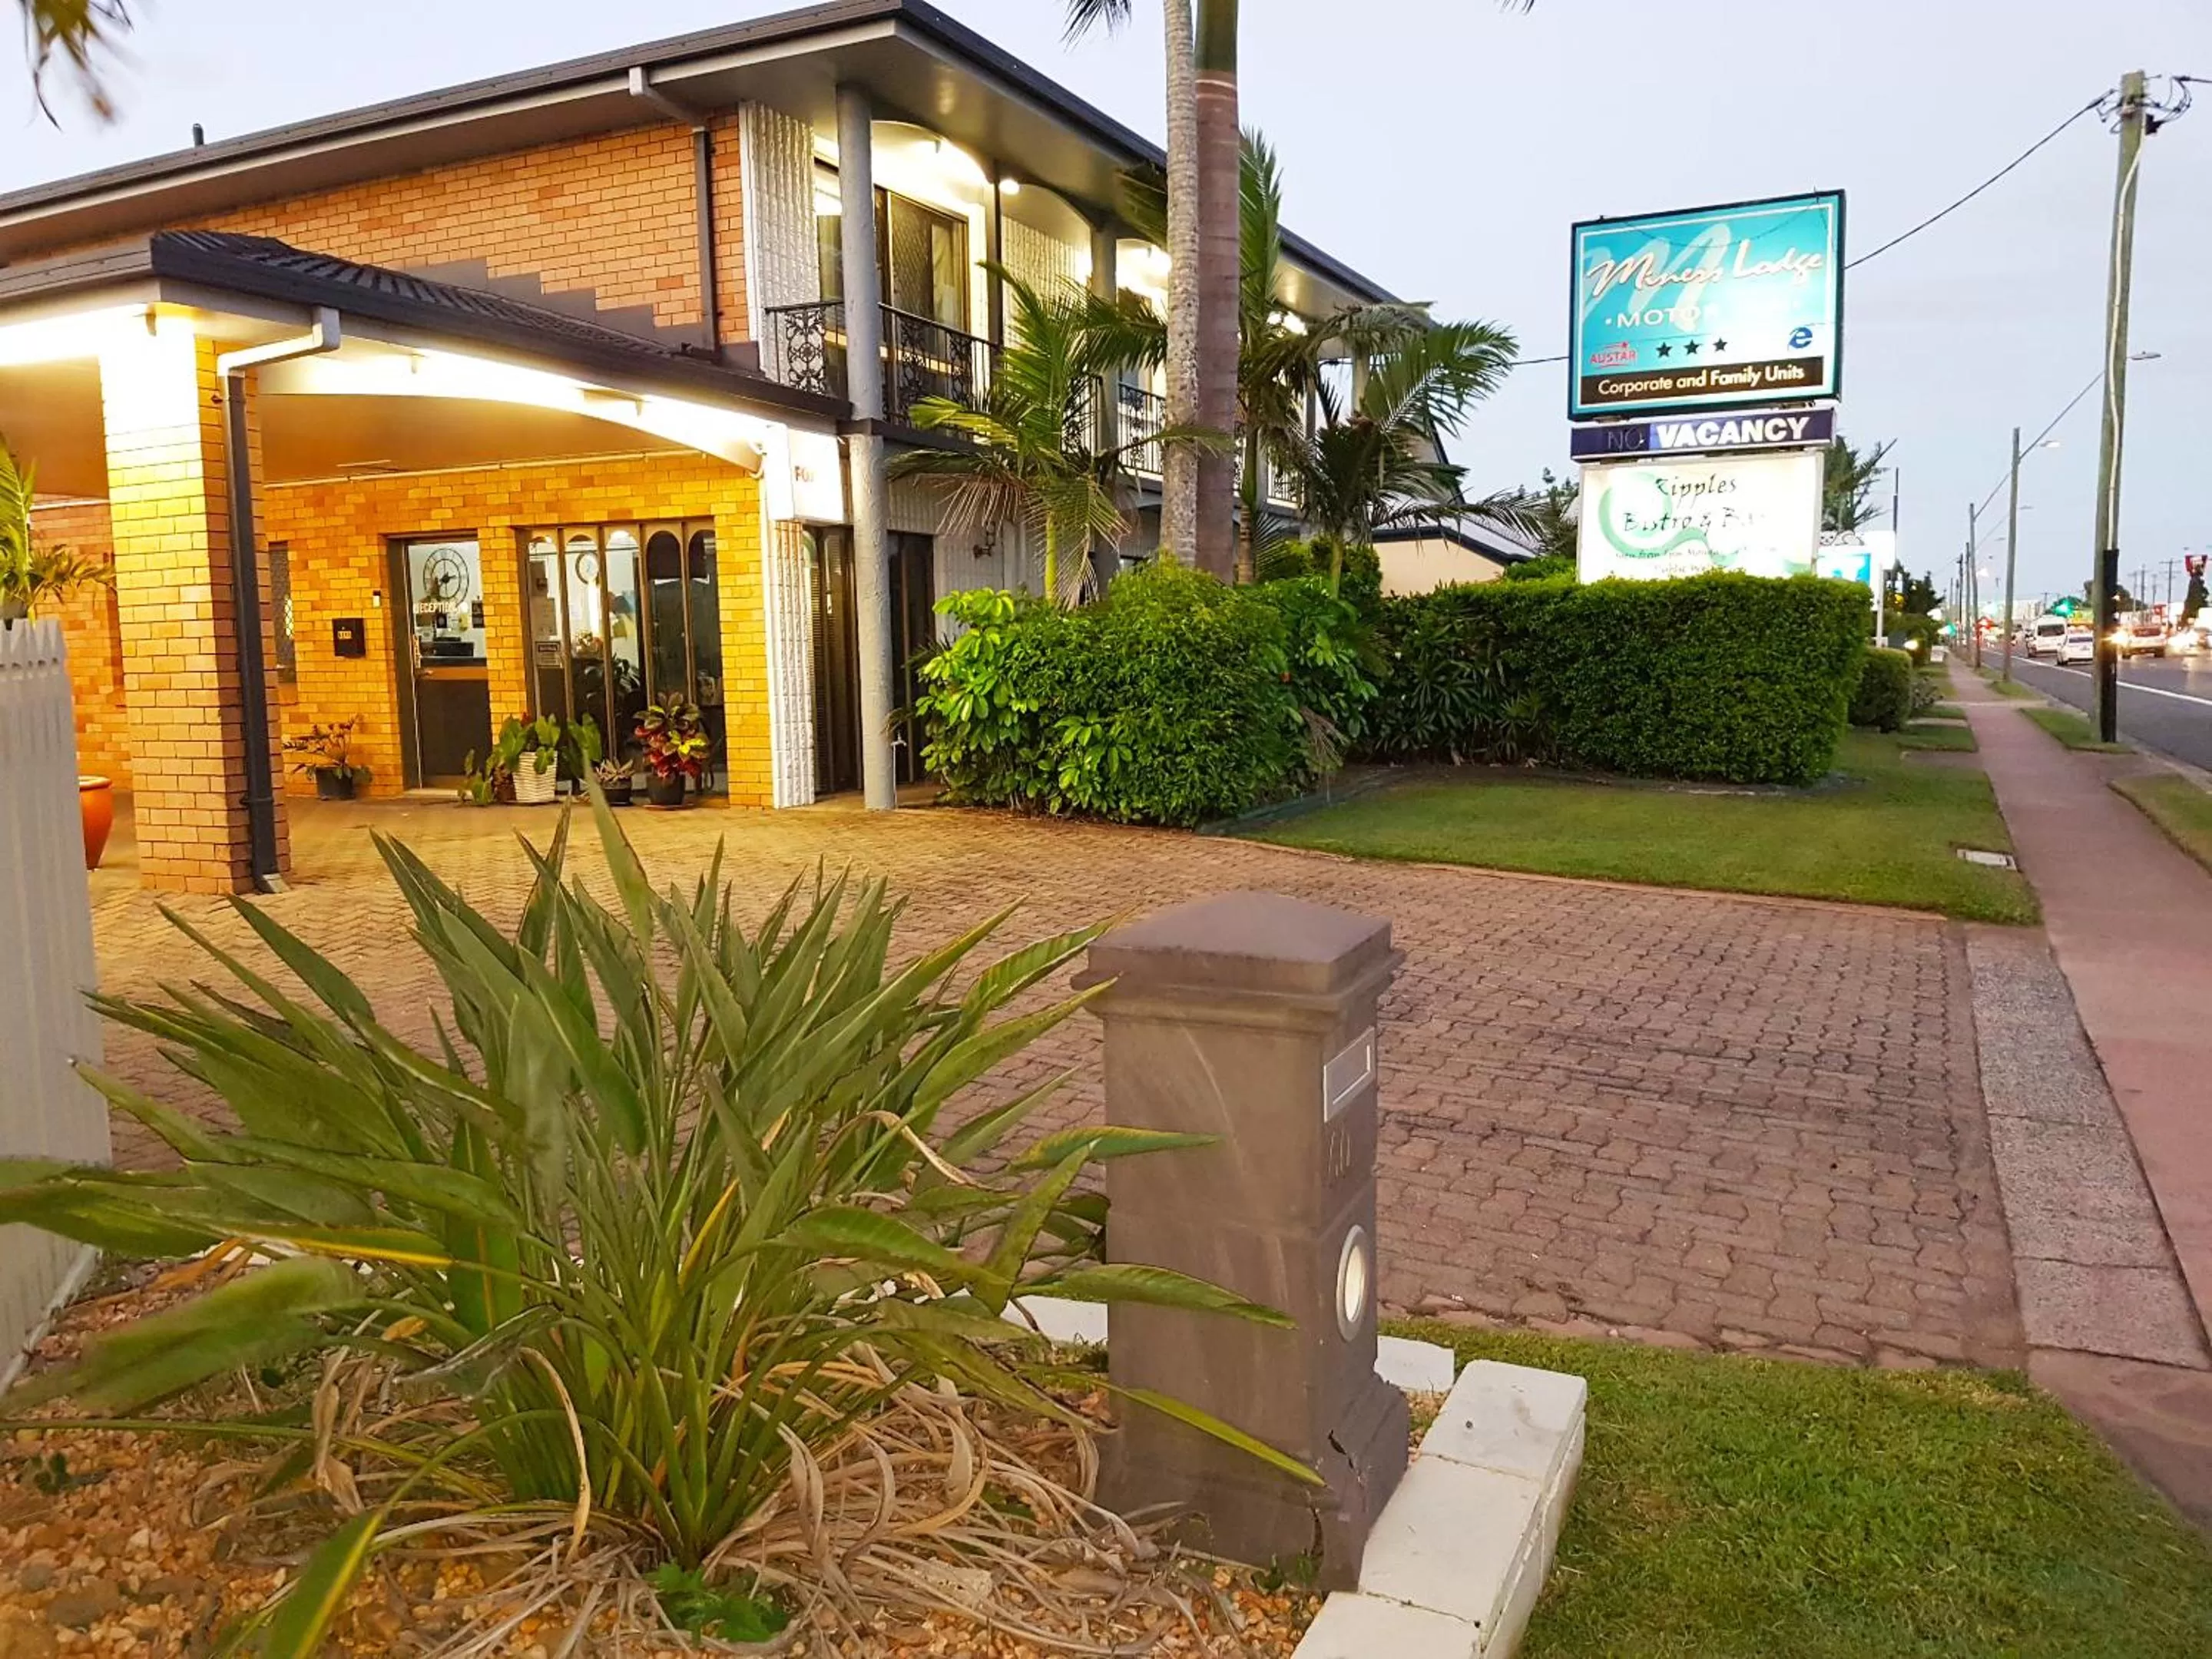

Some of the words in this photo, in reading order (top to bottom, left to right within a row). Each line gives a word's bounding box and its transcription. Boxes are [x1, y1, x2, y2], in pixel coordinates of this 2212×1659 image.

[1591, 350, 1636, 363] AUSTAR
[1598, 376, 1673, 399] Corporate
[1677, 369, 1707, 389] and
[1710, 365, 1761, 388] Family
[1765, 364, 1805, 381] Units
[1656, 416, 1810, 449] VACANCY
[1621, 512, 1693, 532] Bistro
